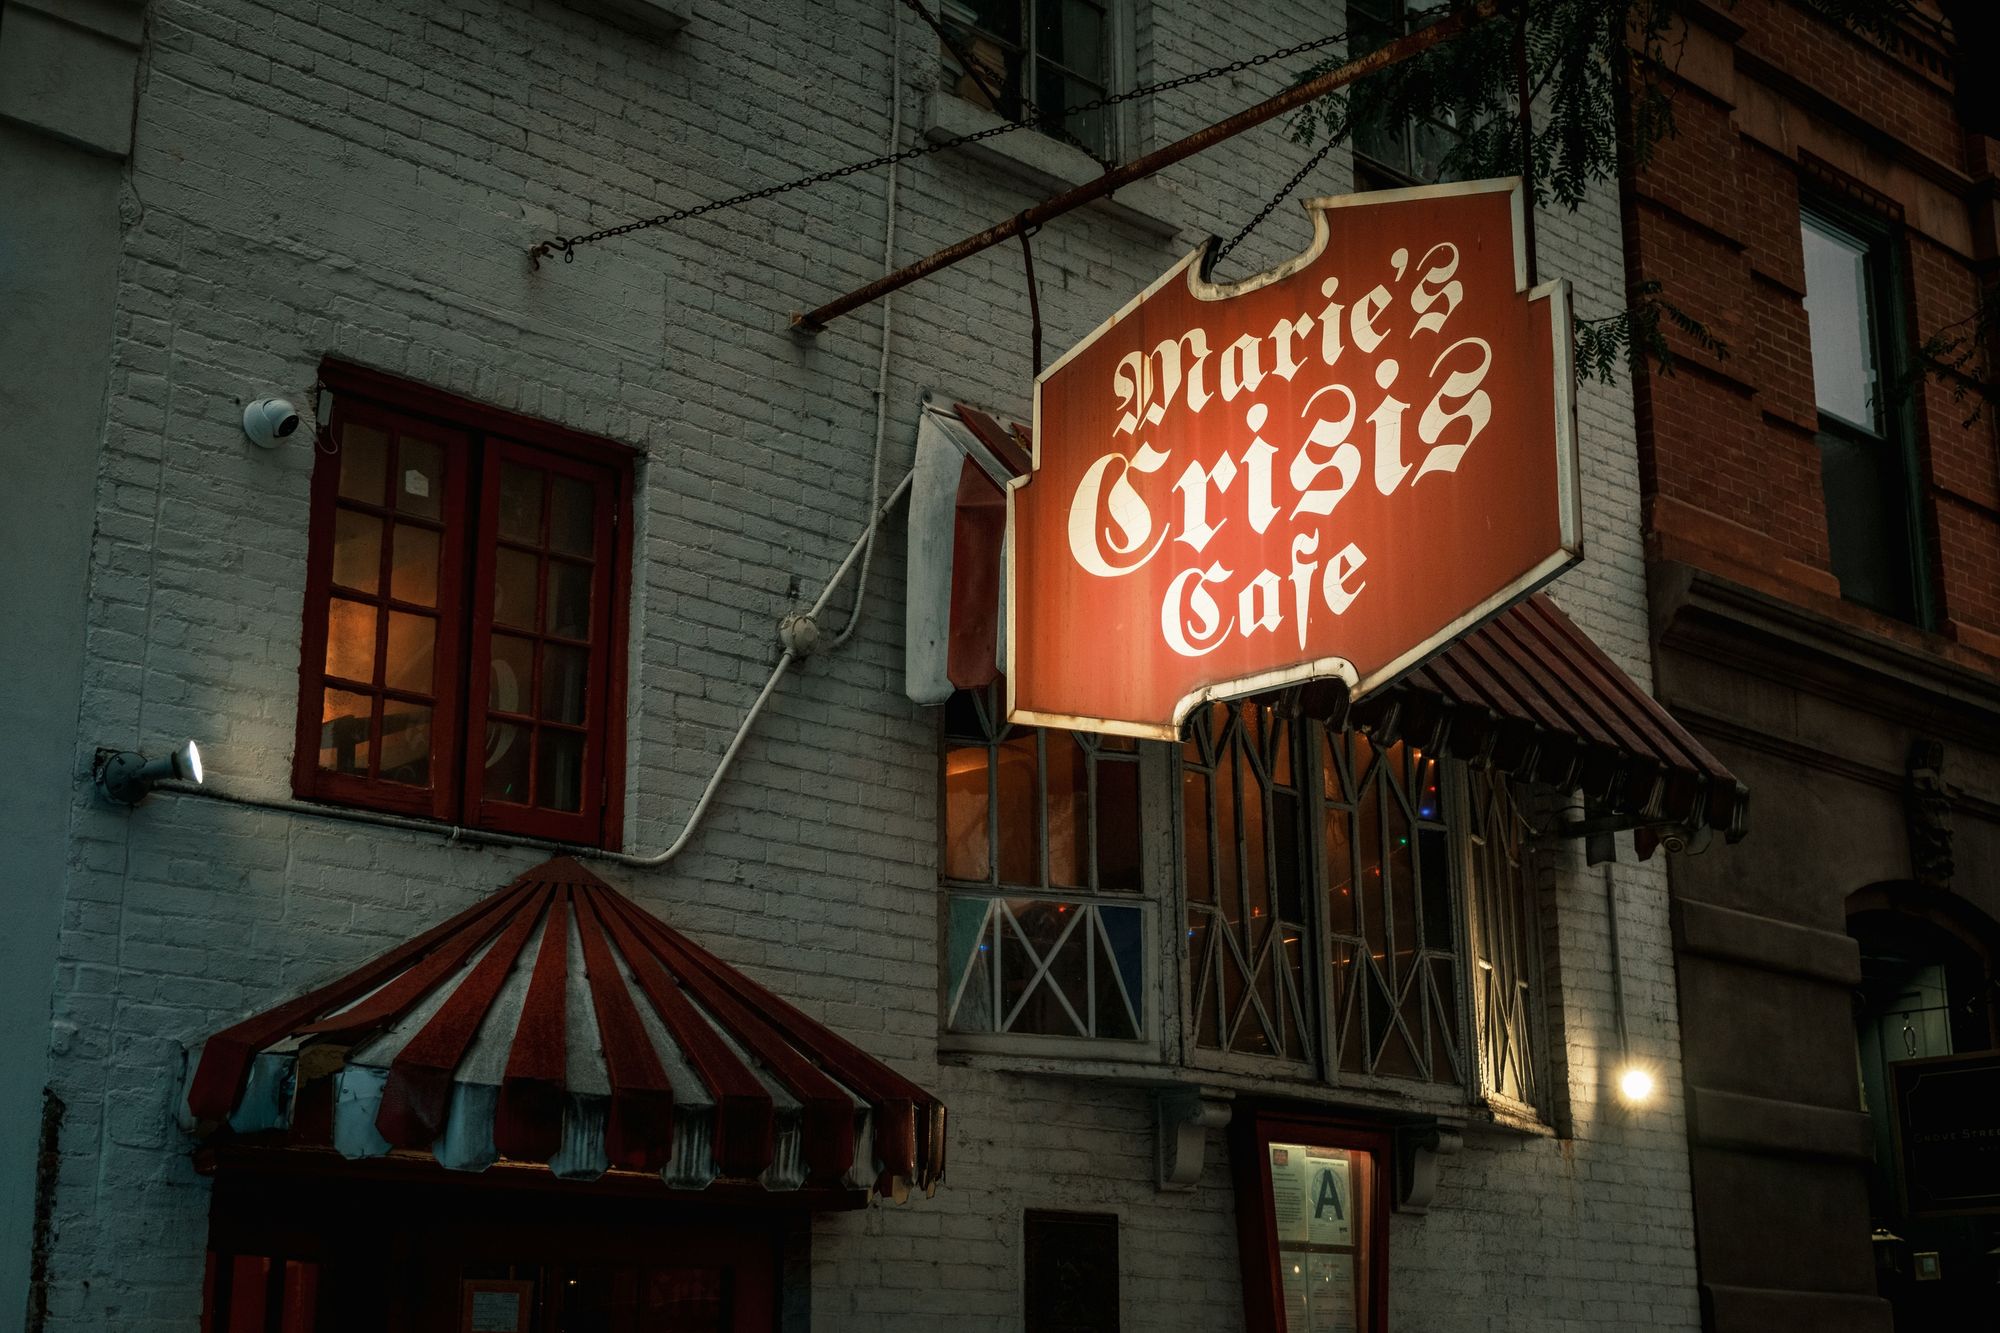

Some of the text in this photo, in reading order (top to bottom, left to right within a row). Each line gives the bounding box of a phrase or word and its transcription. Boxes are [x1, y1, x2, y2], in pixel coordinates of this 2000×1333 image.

[1112, 242, 1464, 438] Marie's
[1161, 528, 1367, 657] Cafe
[1314, 1168, 1345, 1221] A
